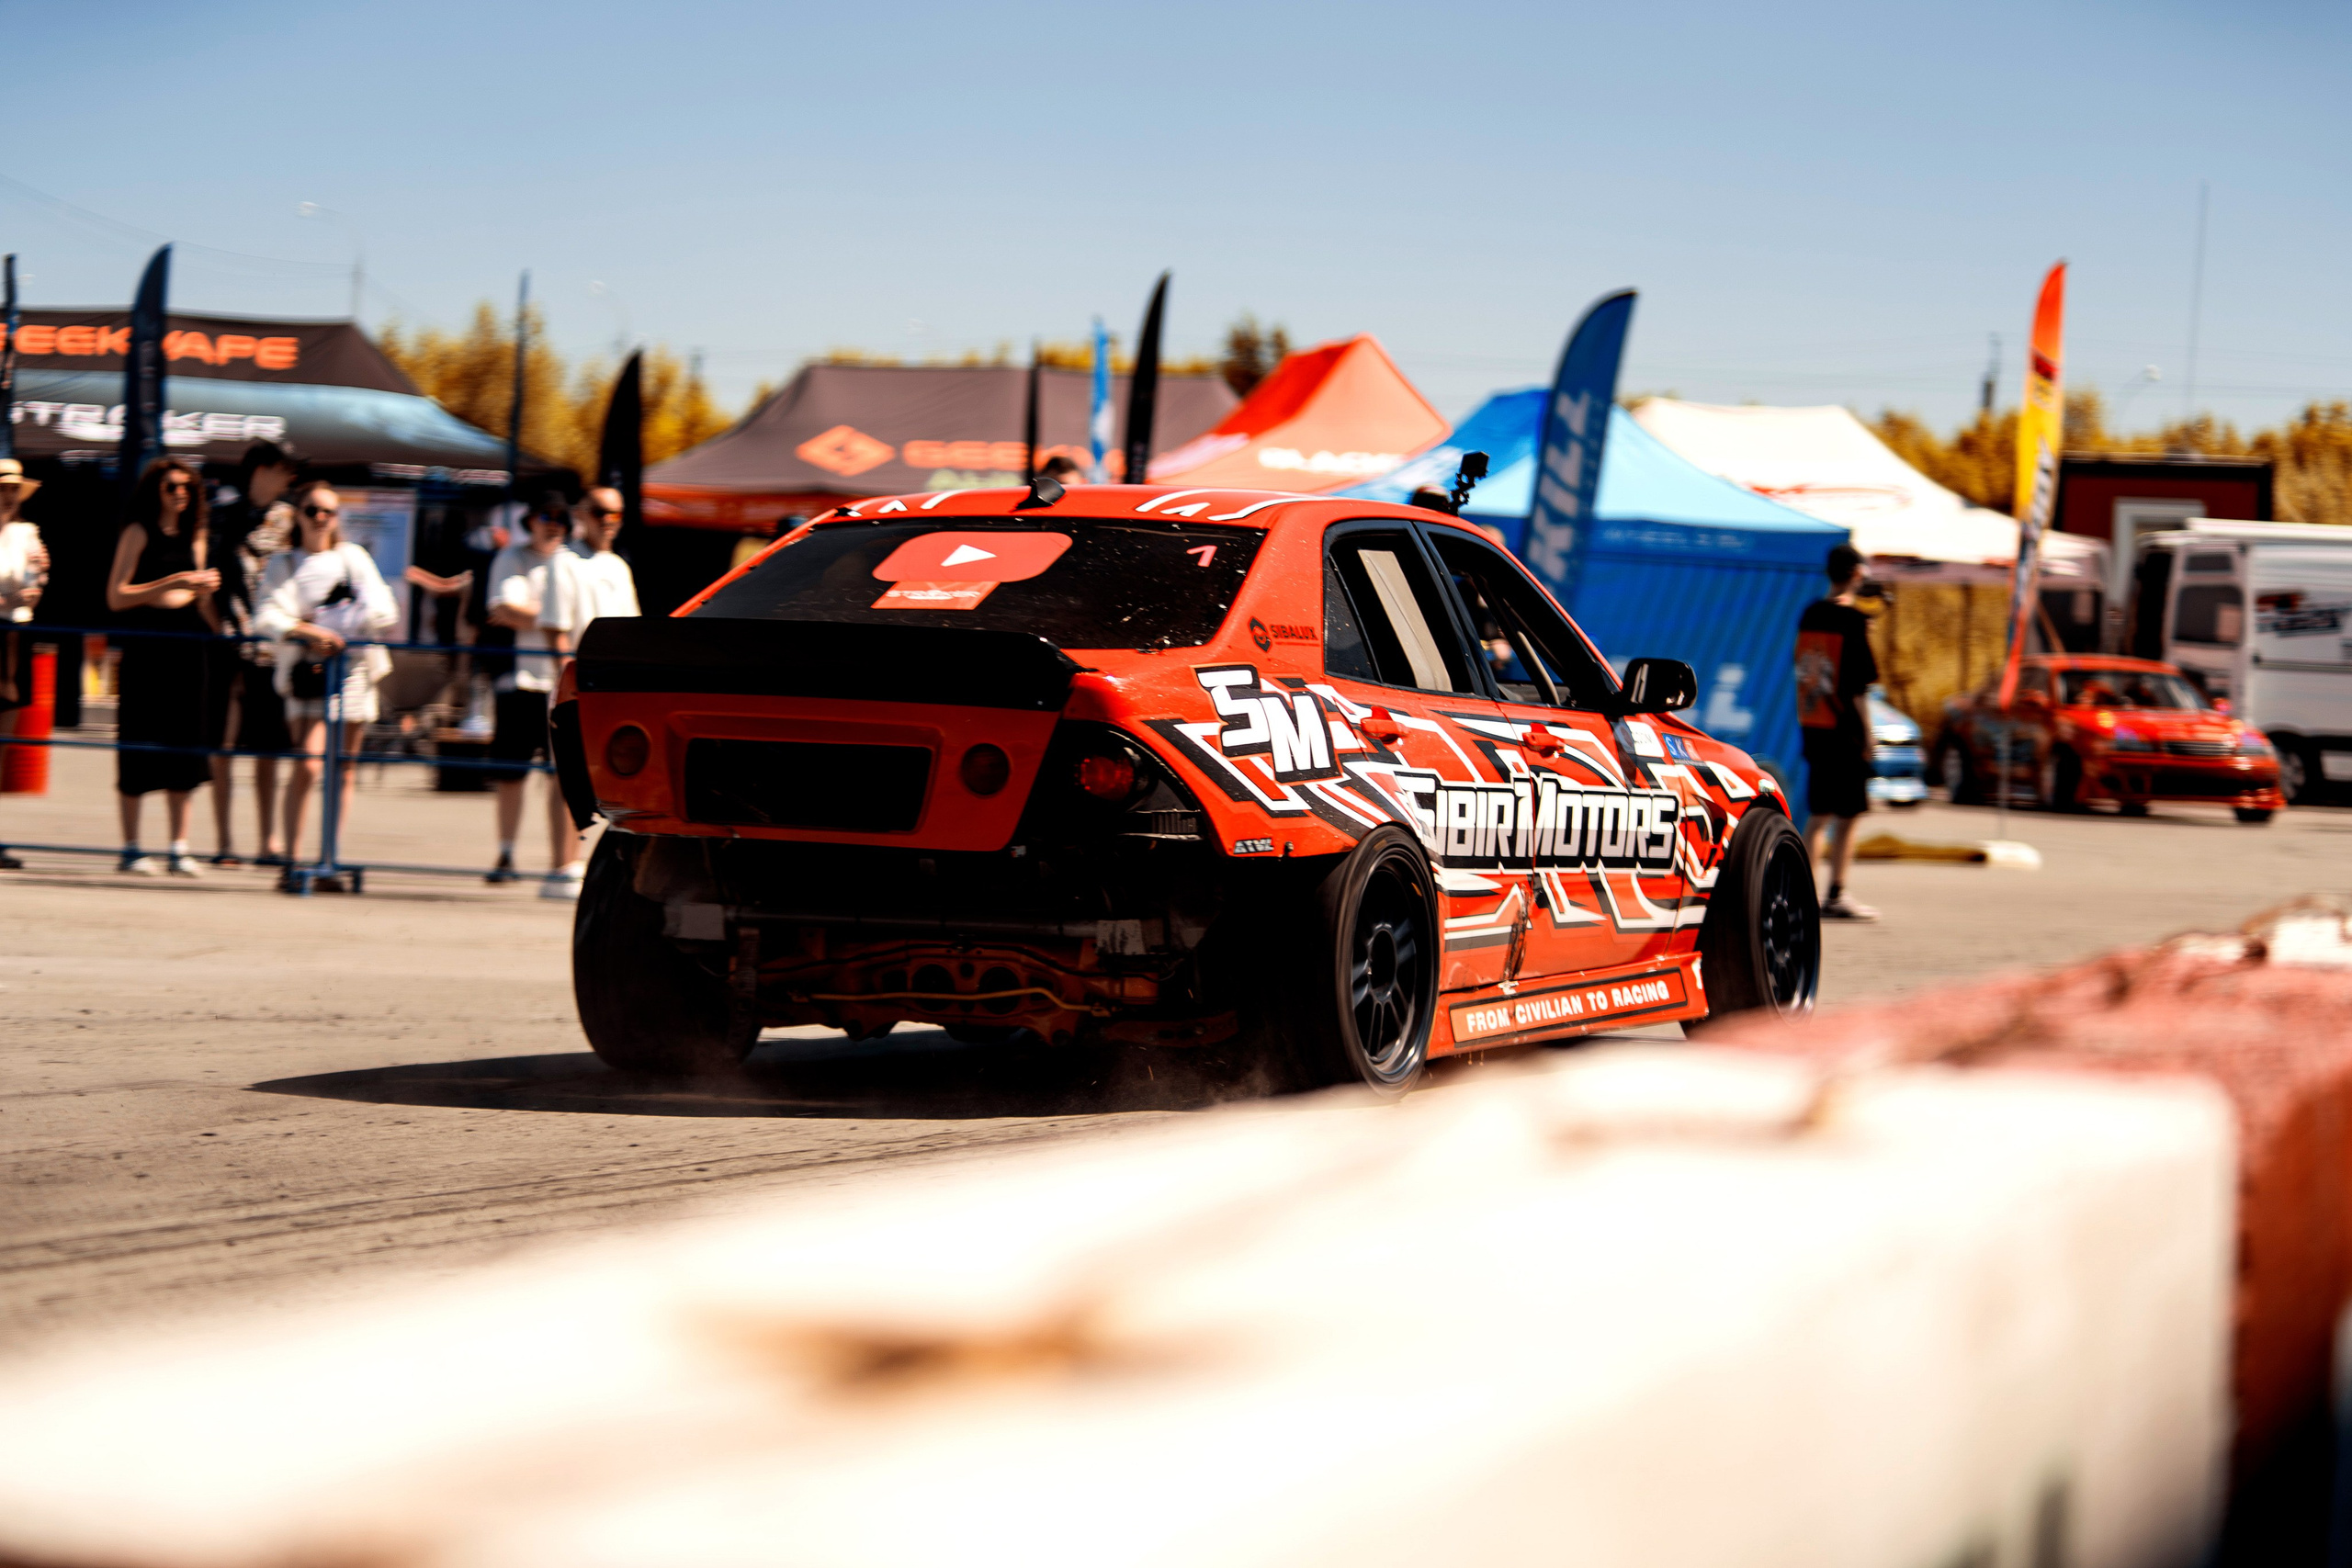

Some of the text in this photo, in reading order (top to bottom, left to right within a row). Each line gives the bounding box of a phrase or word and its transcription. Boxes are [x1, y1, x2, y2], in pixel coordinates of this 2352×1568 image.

[0, 322, 300, 370] EEKVAPE
[1270, 625, 1319, 640] SIBALUX
[1196, 669, 1332, 773] SM
[1466, 980, 1670, 1033] FROM CIVILIAN TO RACING
